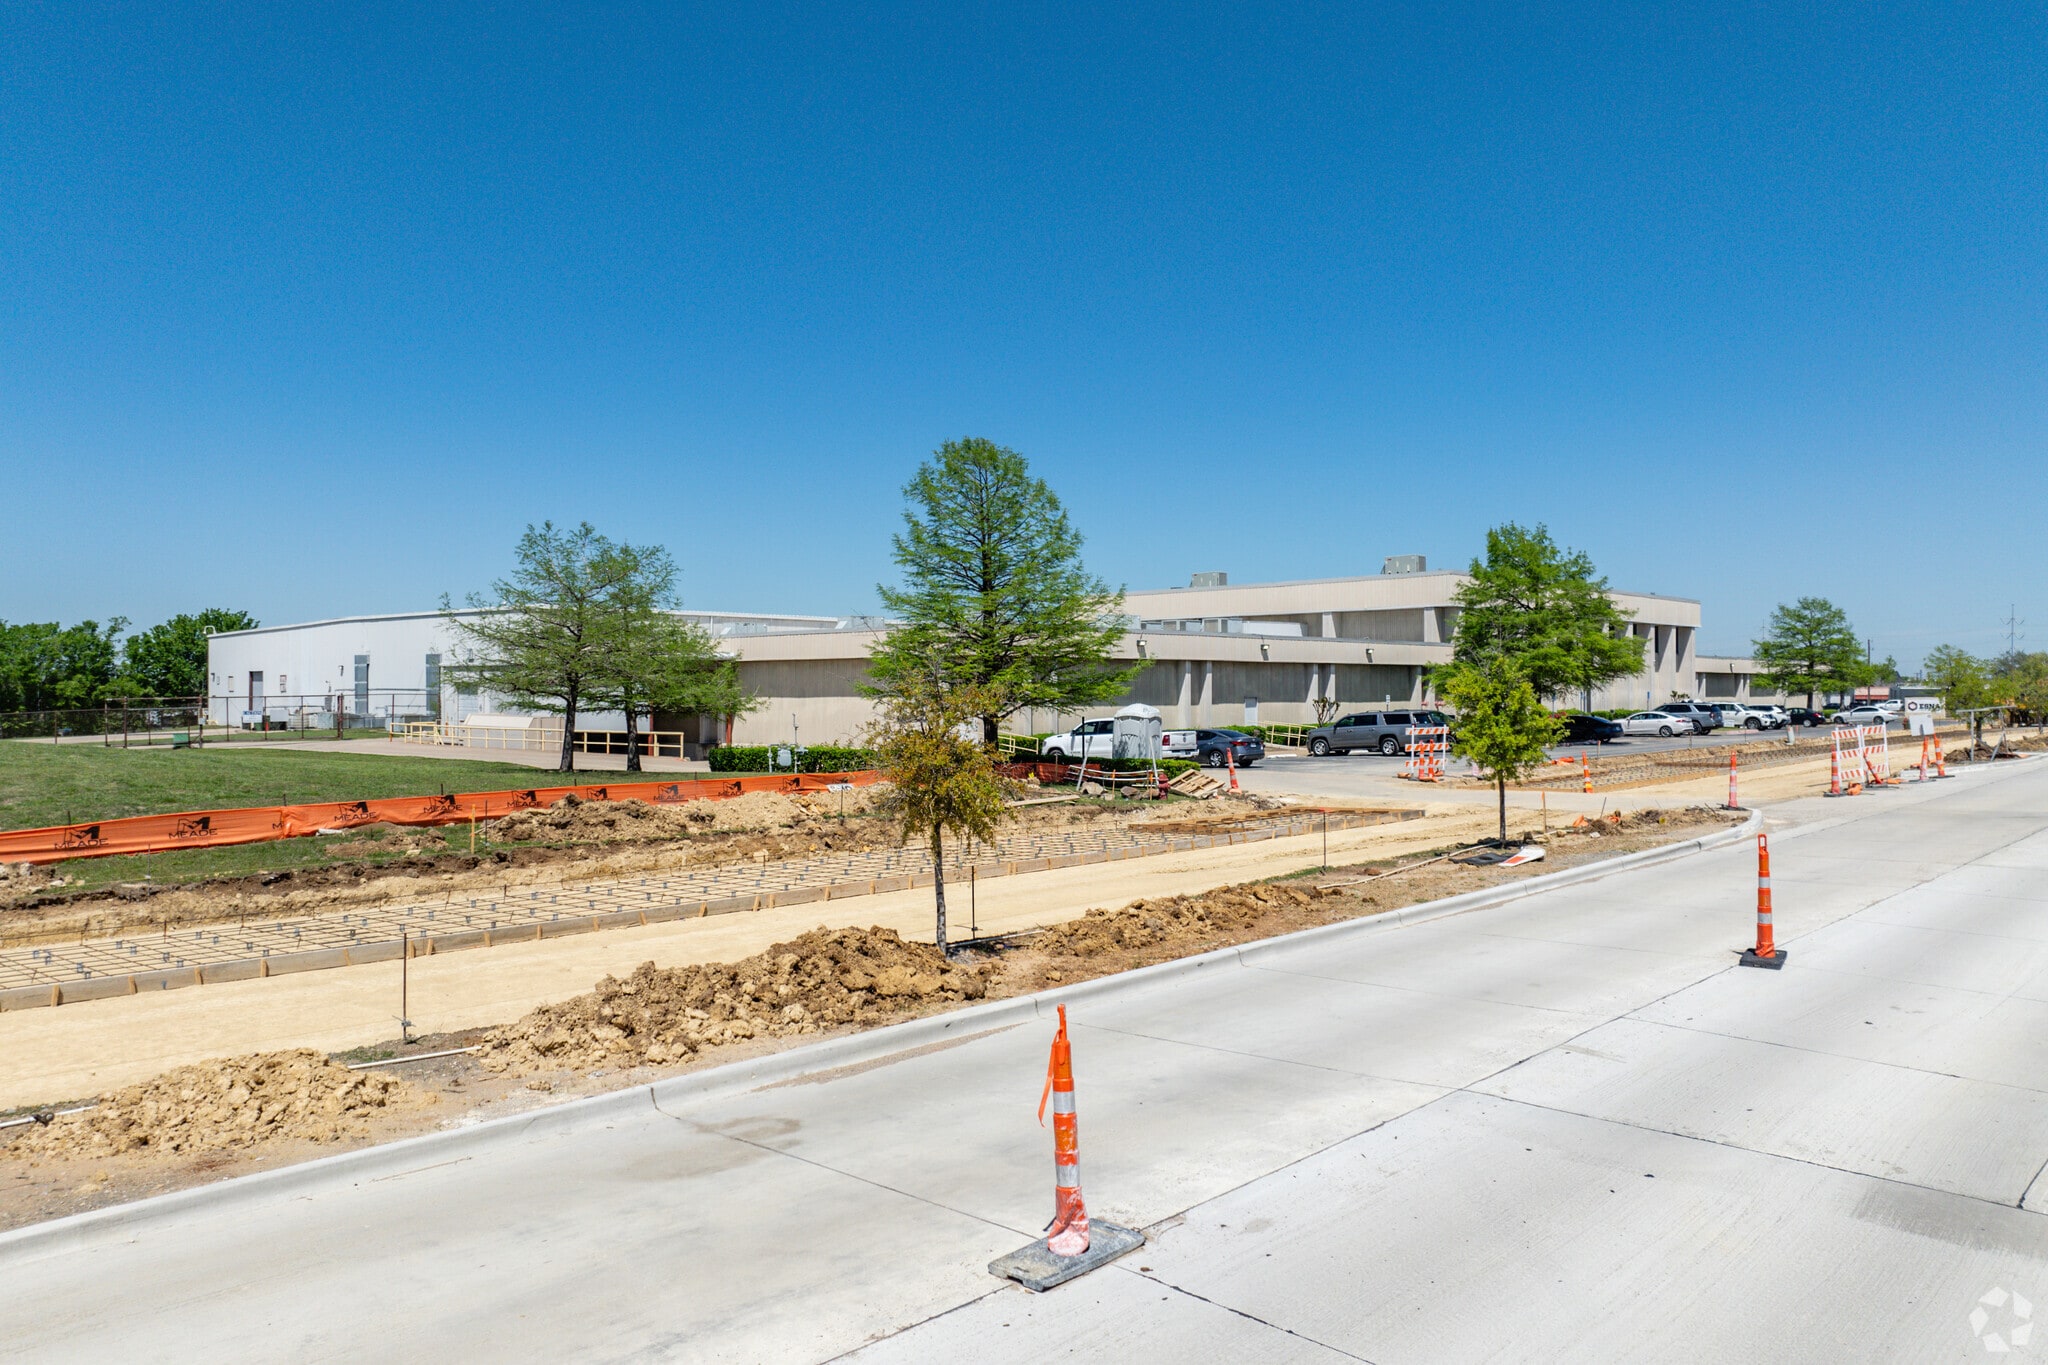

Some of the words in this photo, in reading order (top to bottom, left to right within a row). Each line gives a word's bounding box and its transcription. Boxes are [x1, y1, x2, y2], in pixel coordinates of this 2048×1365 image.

[423, 804, 463, 814] MEADE
[334, 812, 377, 822] MEADE
[168, 828, 218, 840] MEADE
[54, 838, 109, 850] MEADE
